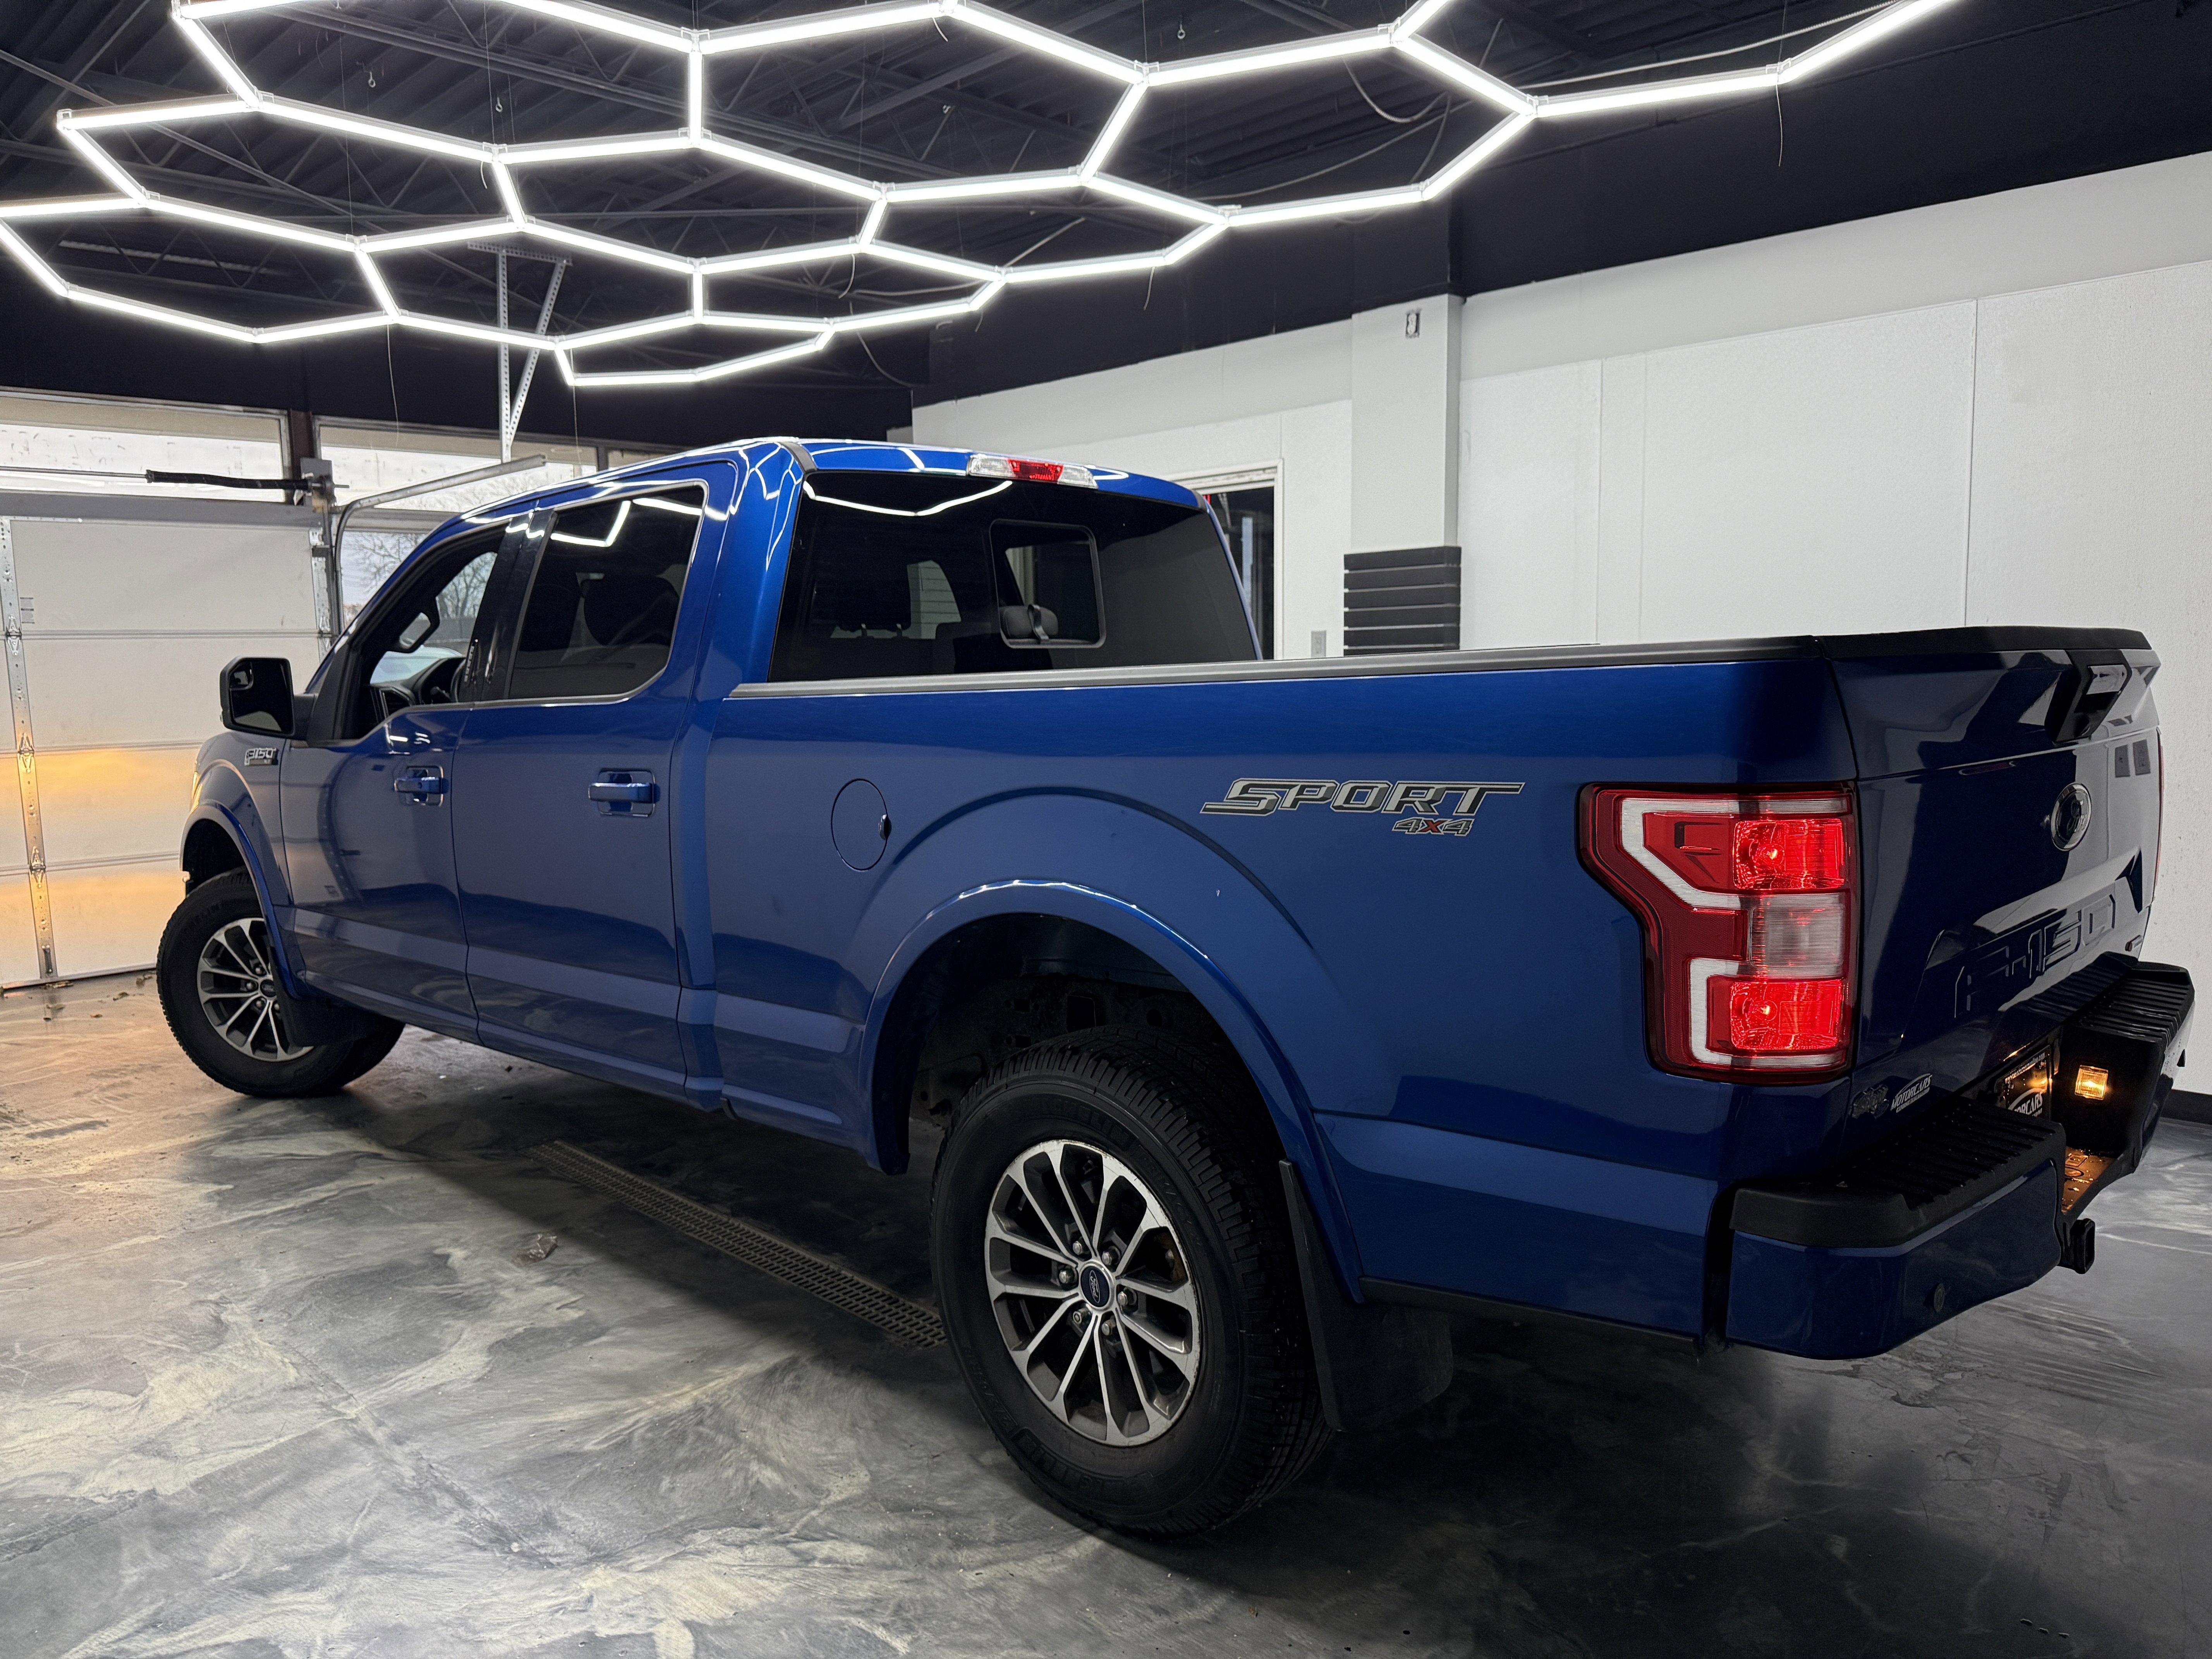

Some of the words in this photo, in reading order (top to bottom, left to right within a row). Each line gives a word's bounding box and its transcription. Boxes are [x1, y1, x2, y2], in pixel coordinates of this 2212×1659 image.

[1200, 778, 1526, 816] SPORT
[1890, 1074, 1932, 1111] MOTORCARS
[2014, 1092, 2043, 1115] ORCARS
[1090, 1276, 1099, 1298] Ford
